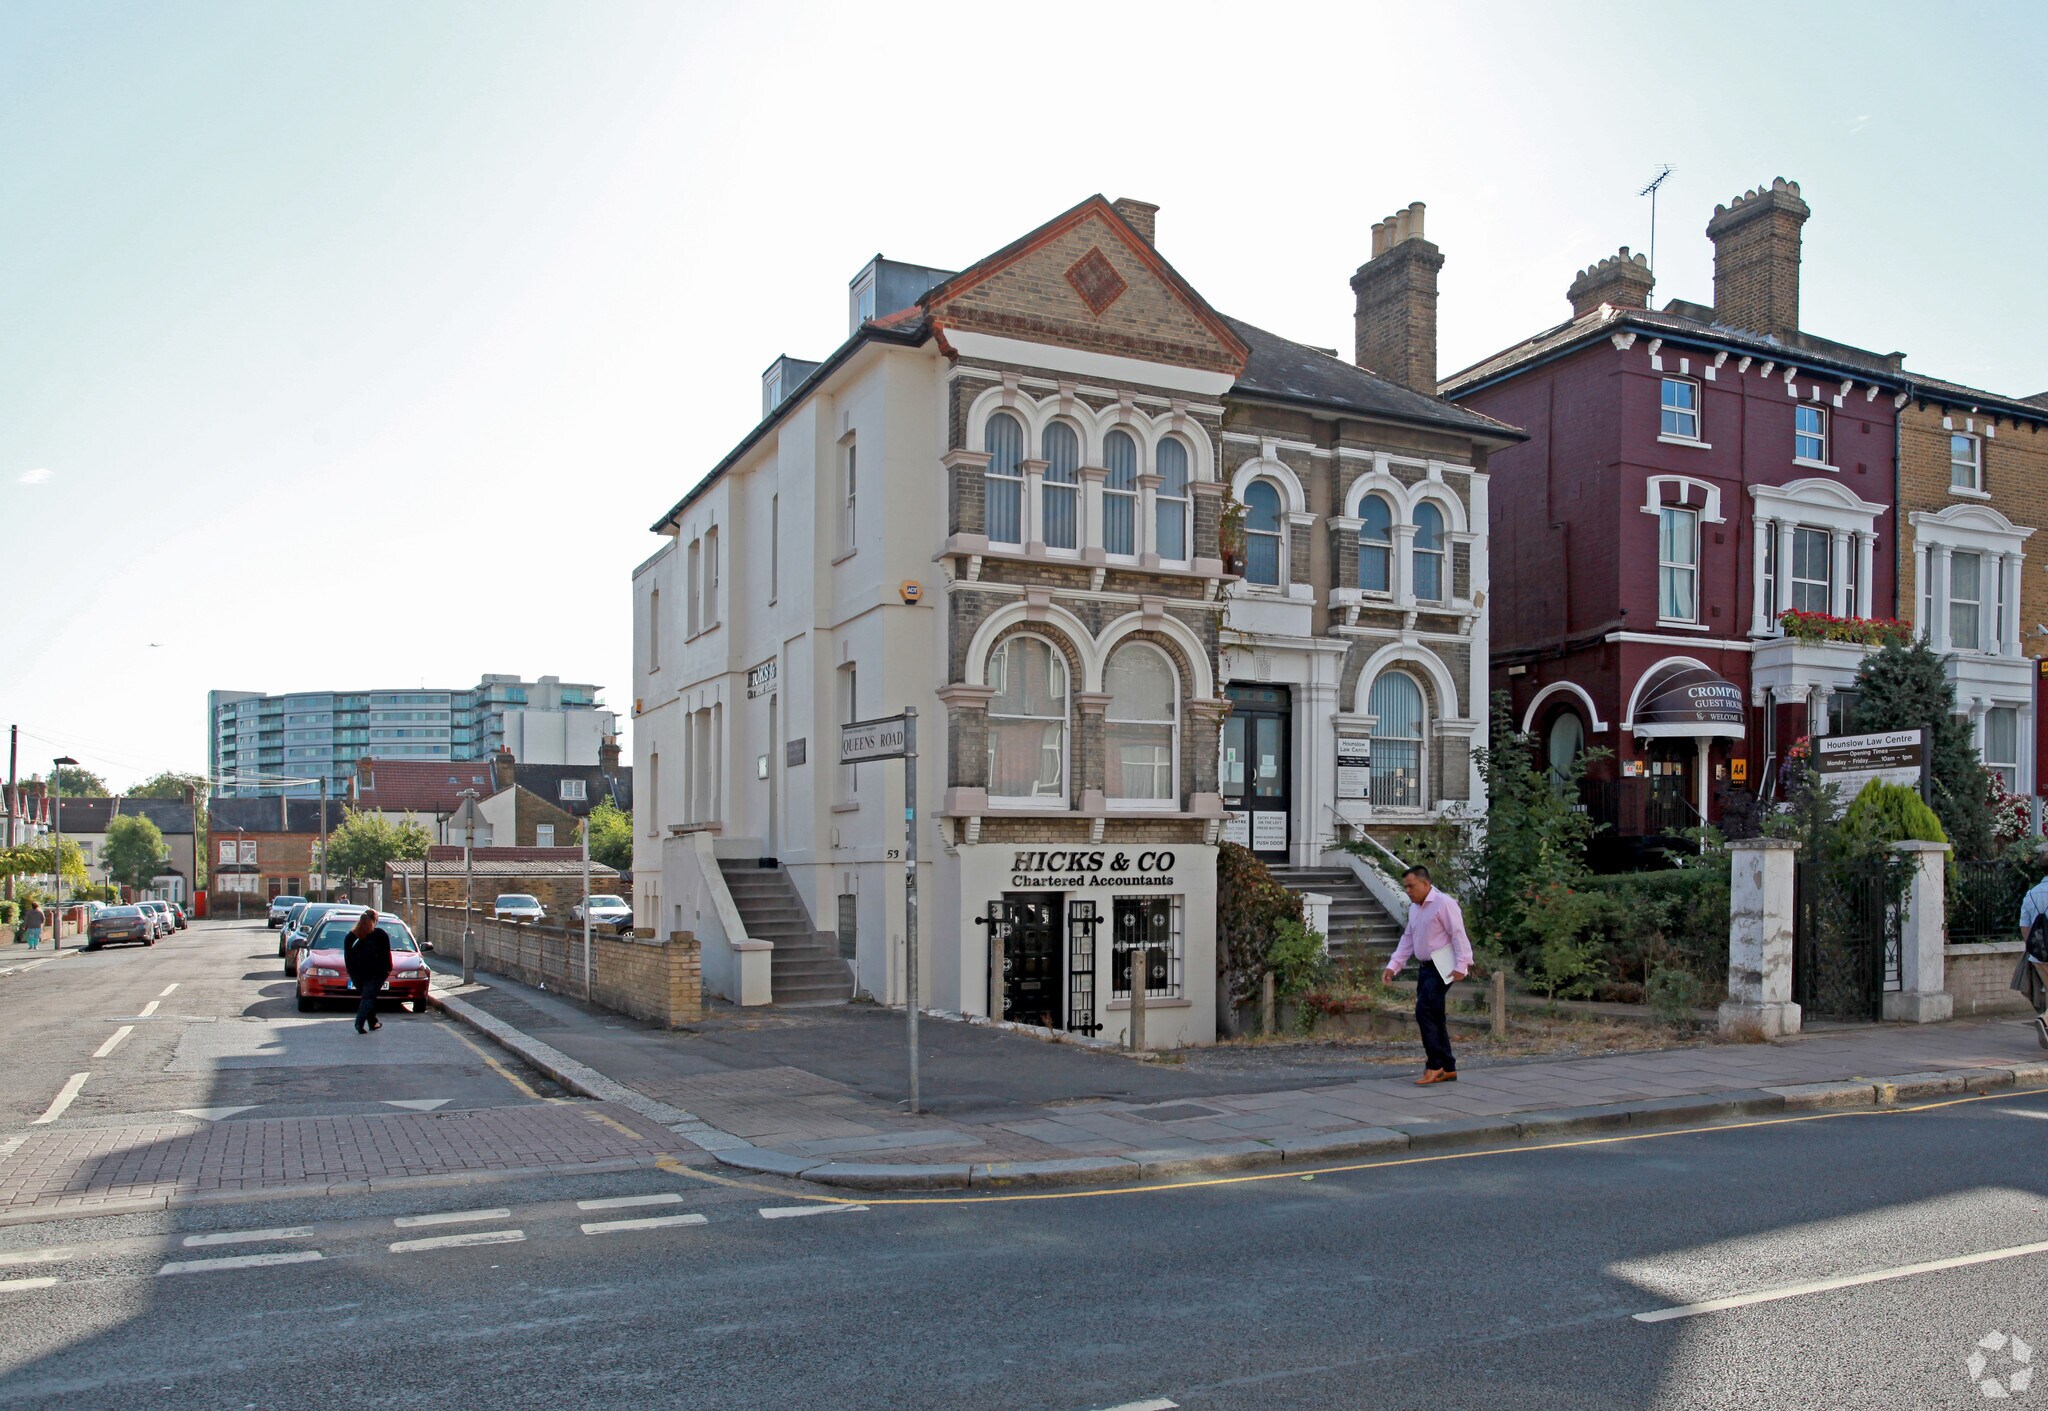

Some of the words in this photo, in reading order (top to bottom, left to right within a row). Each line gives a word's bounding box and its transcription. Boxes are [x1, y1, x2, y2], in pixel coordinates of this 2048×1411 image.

[1695, 700, 1724, 708] GUEST
[1710, 713, 1739, 722] WELCOME
[843, 735, 875, 755] QUEENS
[880, 731, 904, 747] ROAD
[1827, 739, 1863, 749] Hounslow
[1867, 738, 1882, 746] Law
[1886, 735, 1912, 744] Centre
[1849, 749, 1871, 757] Opening
[1732, 764, 1744, 774] AA
[887, 850, 899, 859] 53
[1011, 851, 1105, 872] HICKS
[1109, 852, 1131, 872] &
[1138, 851, 1175, 872] CO
[1012, 875, 1085, 887] Chartered
[1088, 875, 1174, 886] Accountants
